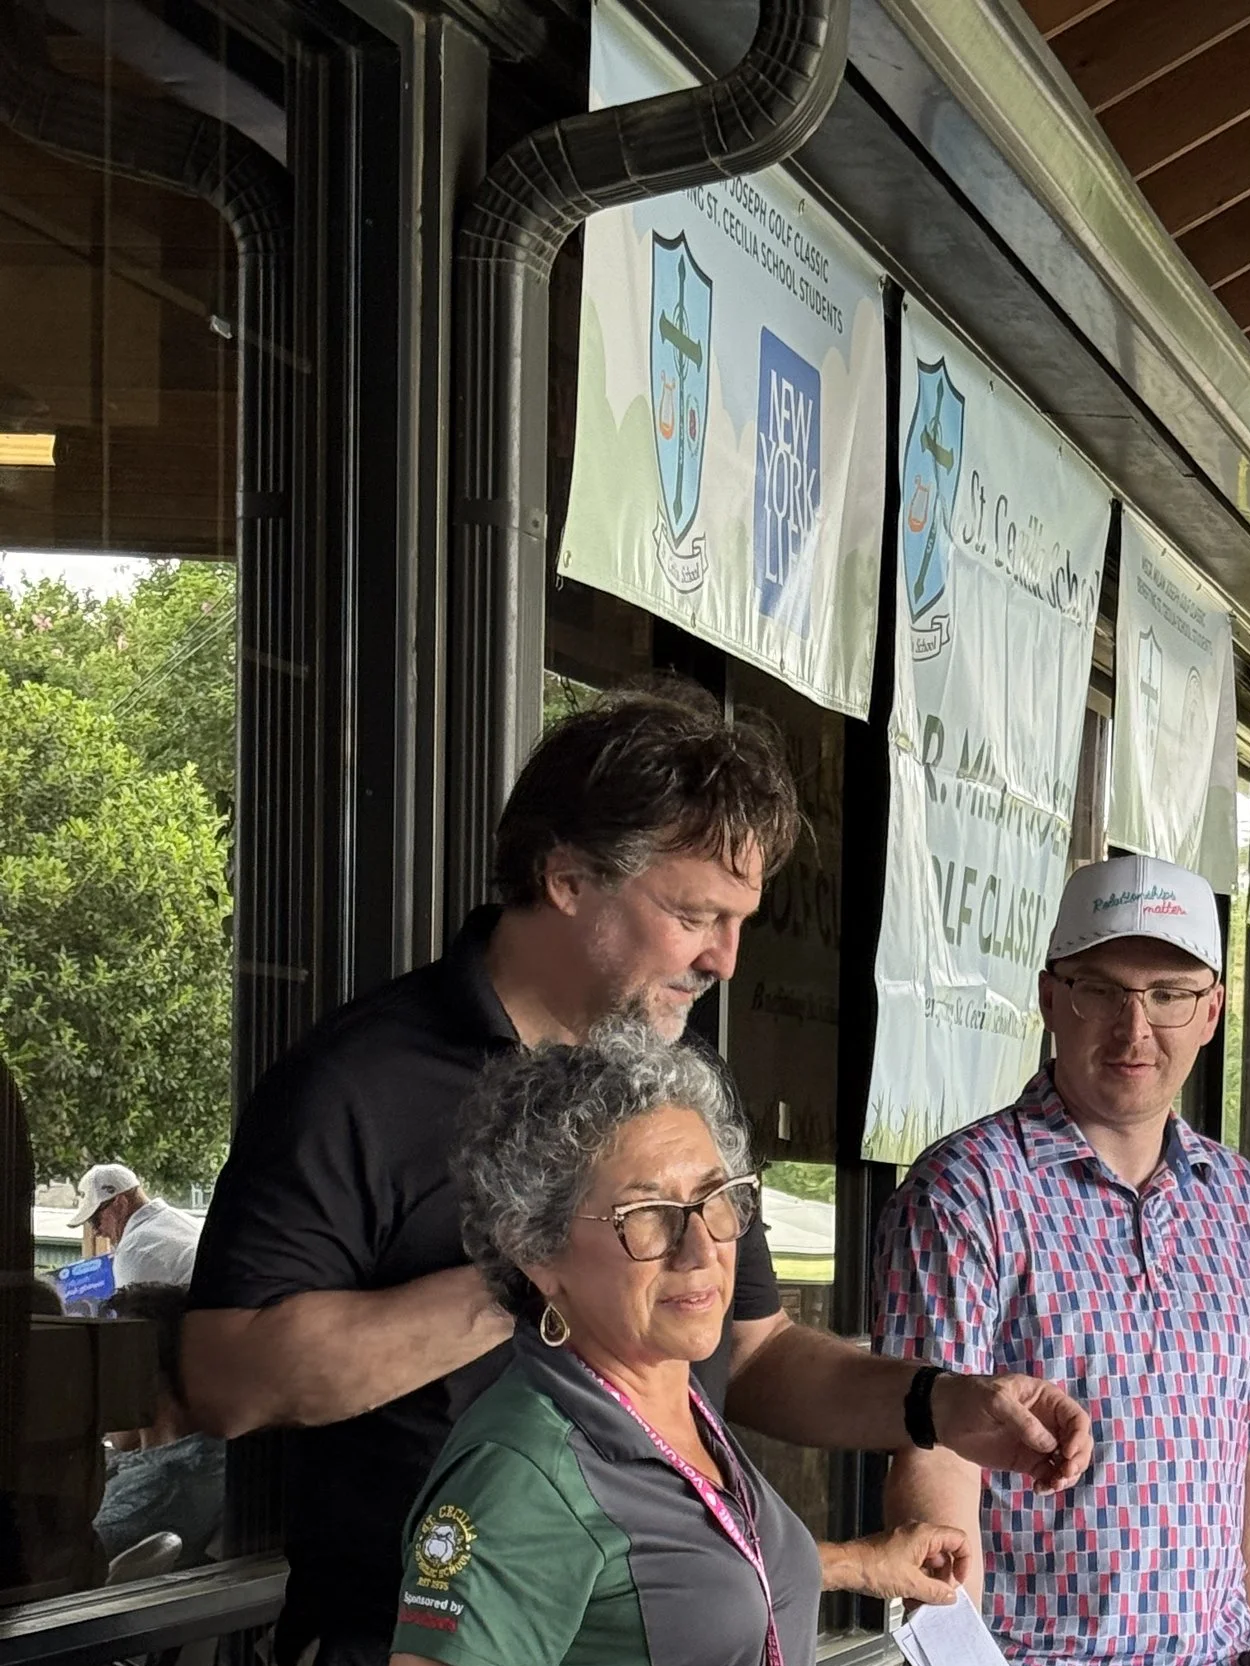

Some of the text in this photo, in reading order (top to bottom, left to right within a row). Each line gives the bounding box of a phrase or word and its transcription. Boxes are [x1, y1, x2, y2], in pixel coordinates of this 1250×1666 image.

[707, 192, 720, 227] ST.
[723, 208, 759, 262] CECILIA
[761, 242, 797, 295] SCHOOL
[800, 277, 843, 334] STUDENTS
[729, 176, 767, 227] JOSEPH
[768, 209, 793, 248] GOLF
[794, 232, 829, 283] CLASSIC
[769, 369, 813, 464] NEW
[760, 432, 816, 535] YORK
[403, 1591, 464, 1616] Sponsored by
